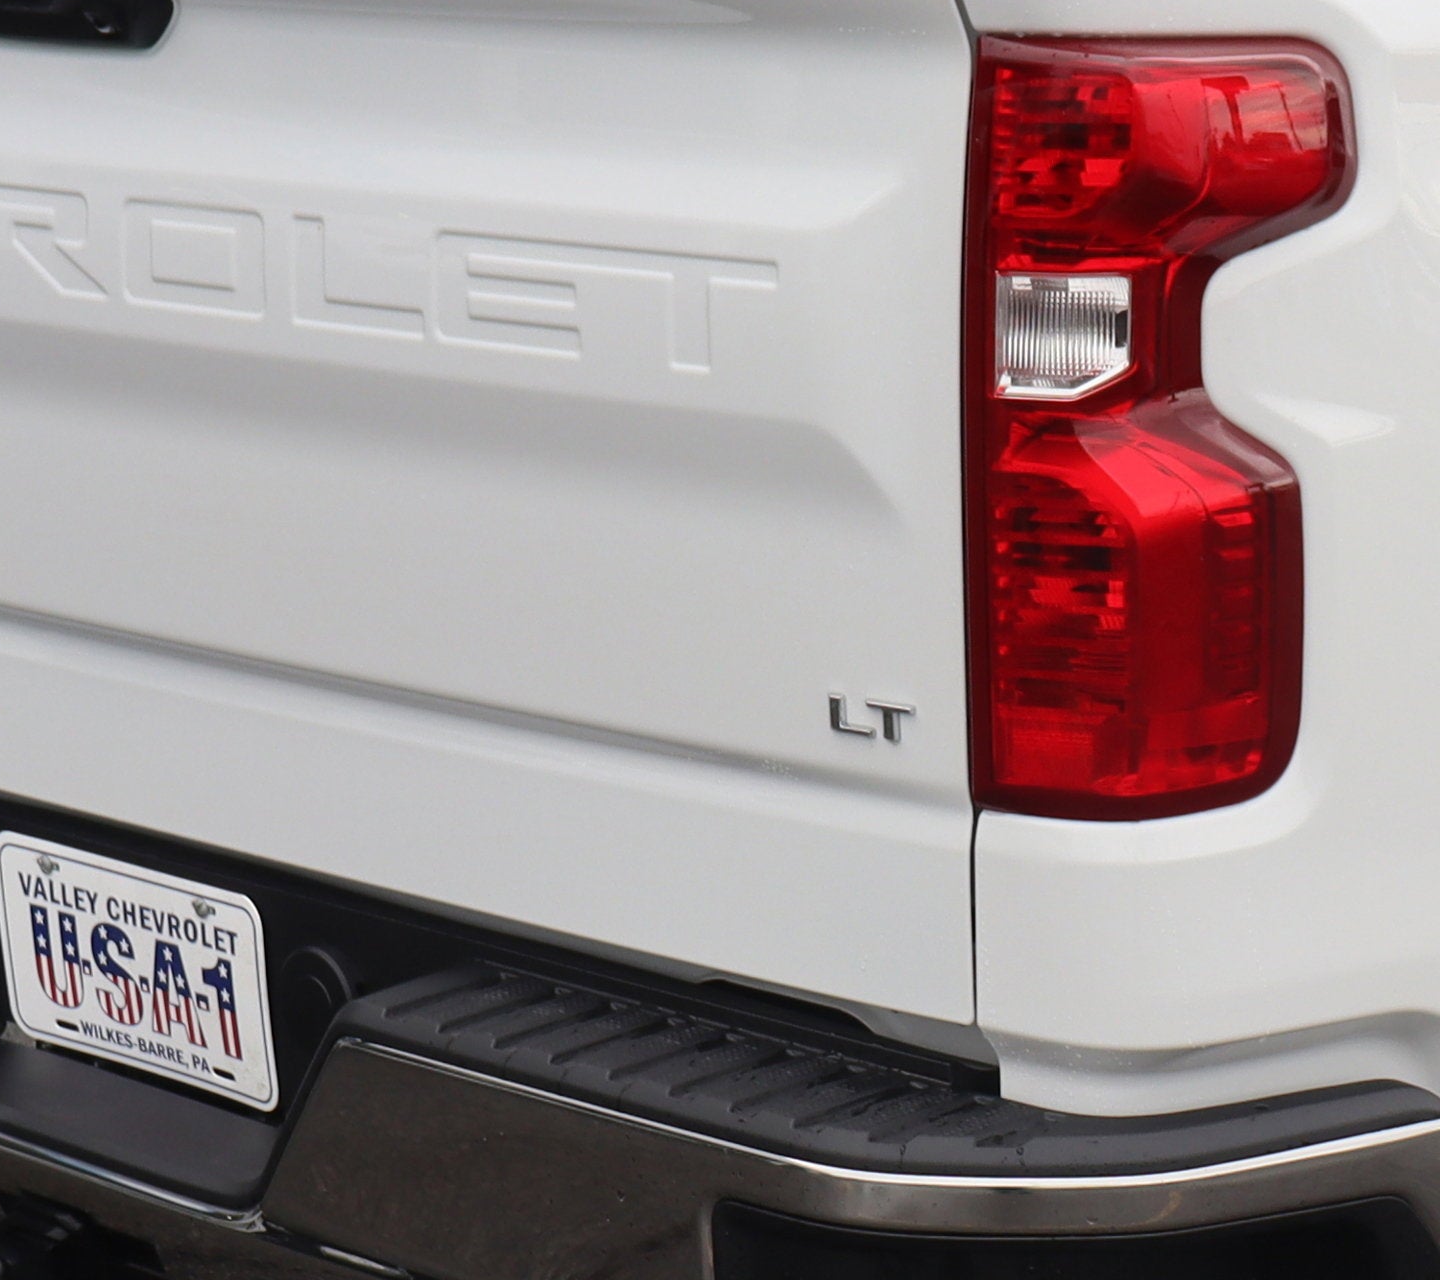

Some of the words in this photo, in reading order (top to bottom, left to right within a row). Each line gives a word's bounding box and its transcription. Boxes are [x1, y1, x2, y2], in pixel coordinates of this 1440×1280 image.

[828, 691, 917, 746] LT
[17, 871, 98, 915] VALLEY
[106, 896, 238, 956] CHEVROLET
[80, 1020, 190, 1069] WILKES-BARRE,
[192, 1053, 211, 1073] PA
